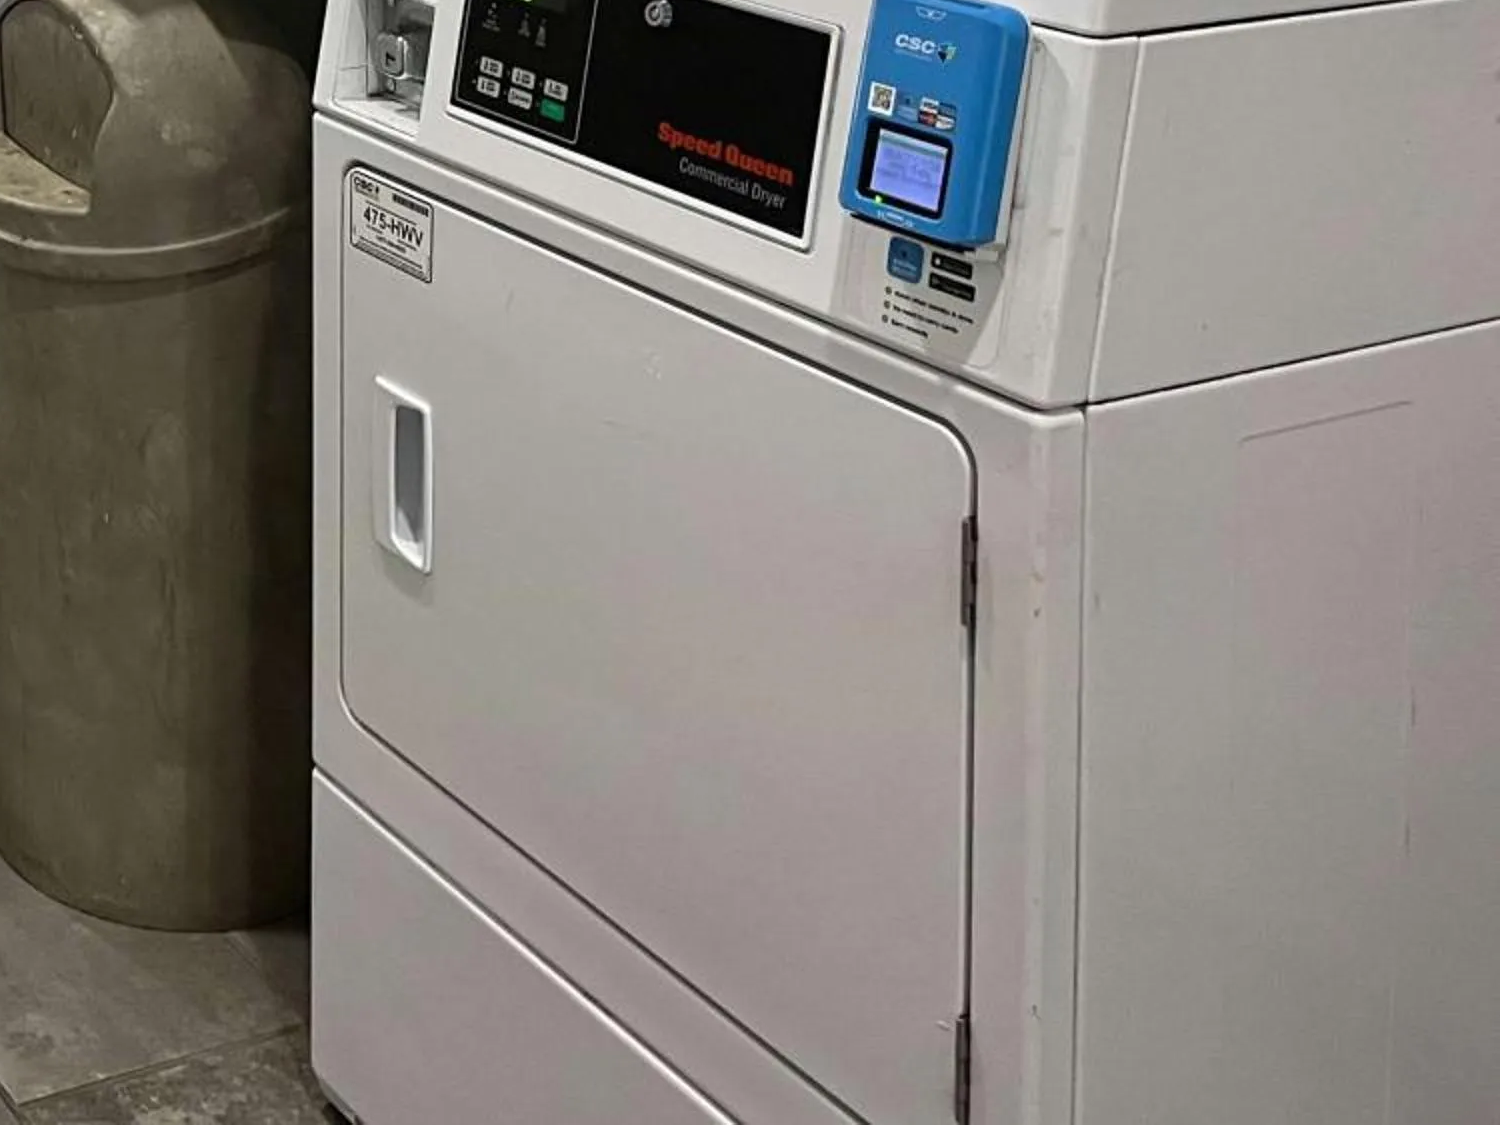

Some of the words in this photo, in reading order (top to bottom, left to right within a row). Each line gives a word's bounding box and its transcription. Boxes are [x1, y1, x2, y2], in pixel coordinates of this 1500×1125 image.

[895, 33, 936, 55] CSC
[657, 121, 722, 161] Speed
[725, 143, 794, 187] Queen
[678, 155, 749, 195] Commercial
[751, 181, 787, 210] Dryer
[363, 206, 424, 247] 475-HWV
